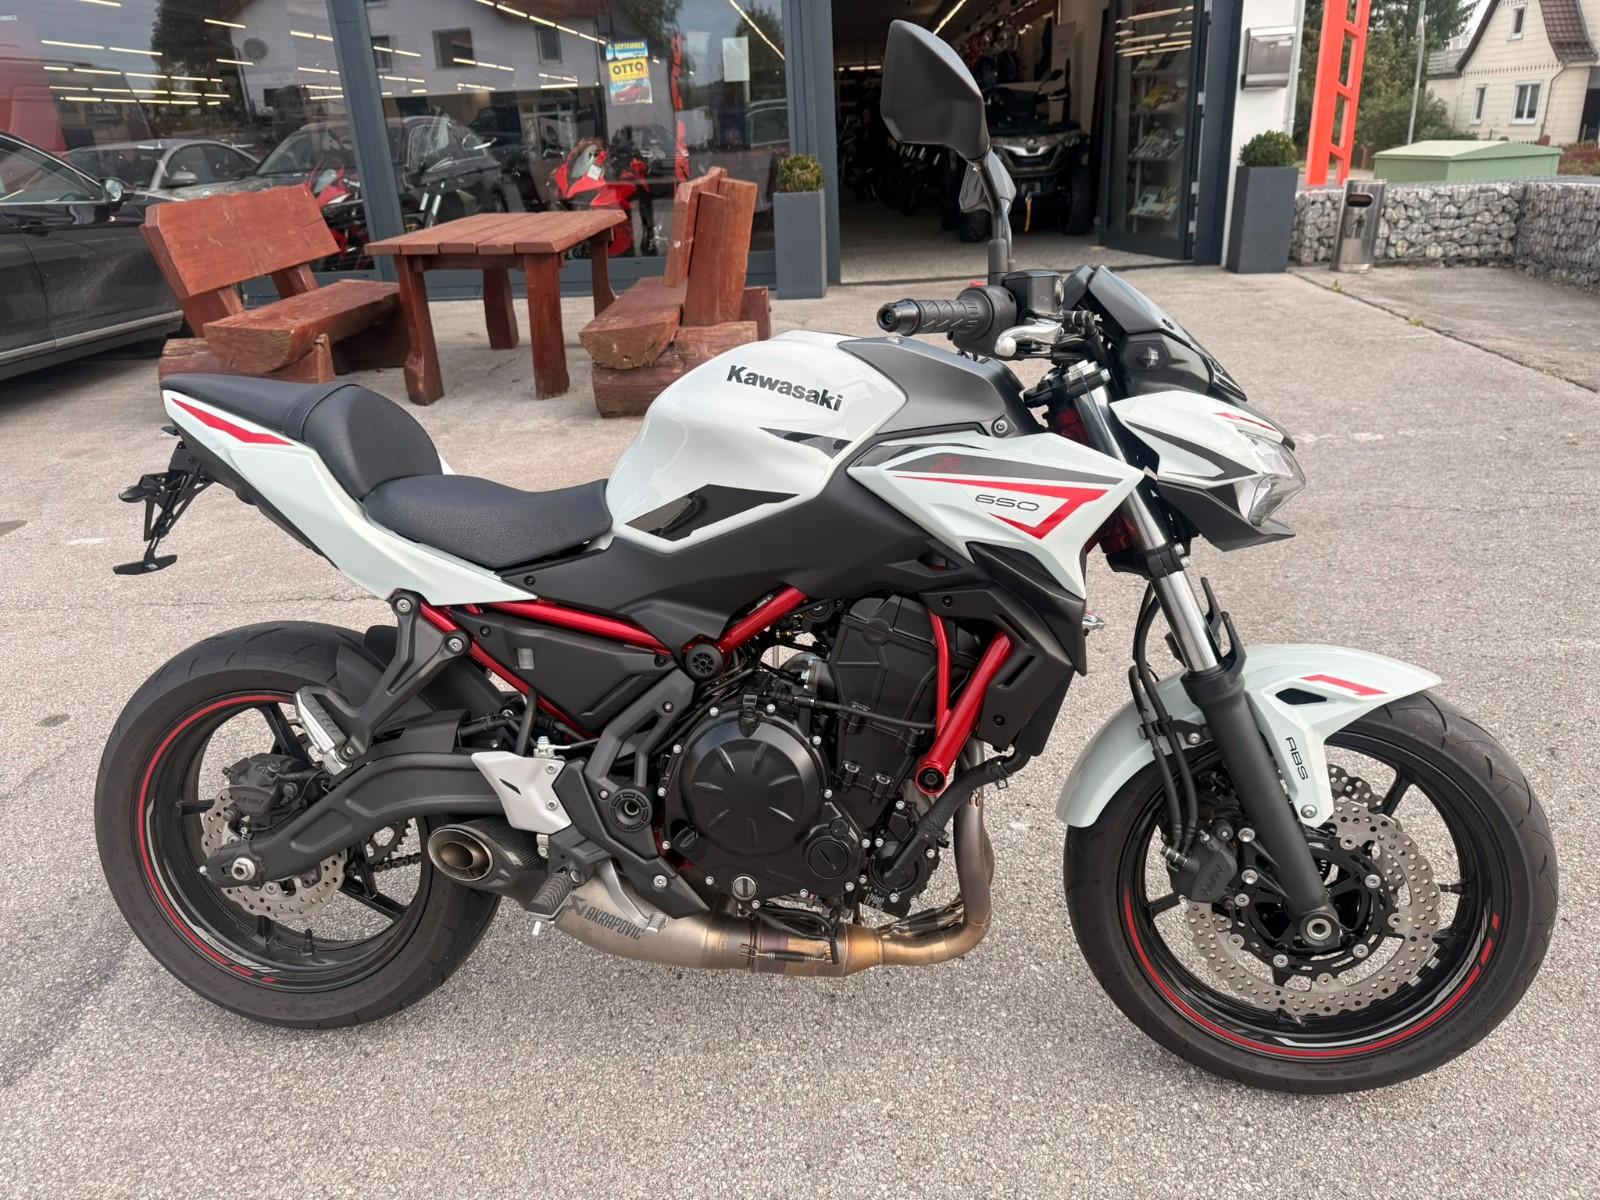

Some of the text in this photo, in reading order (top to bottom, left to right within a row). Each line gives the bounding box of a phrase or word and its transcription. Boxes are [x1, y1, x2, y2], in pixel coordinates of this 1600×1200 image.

[612, 61, 644, 75] OTTO
[726, 365, 844, 412] Kawasaki
[975, 494, 1040, 512] 650
[1285, 736, 1309, 780] ABS
